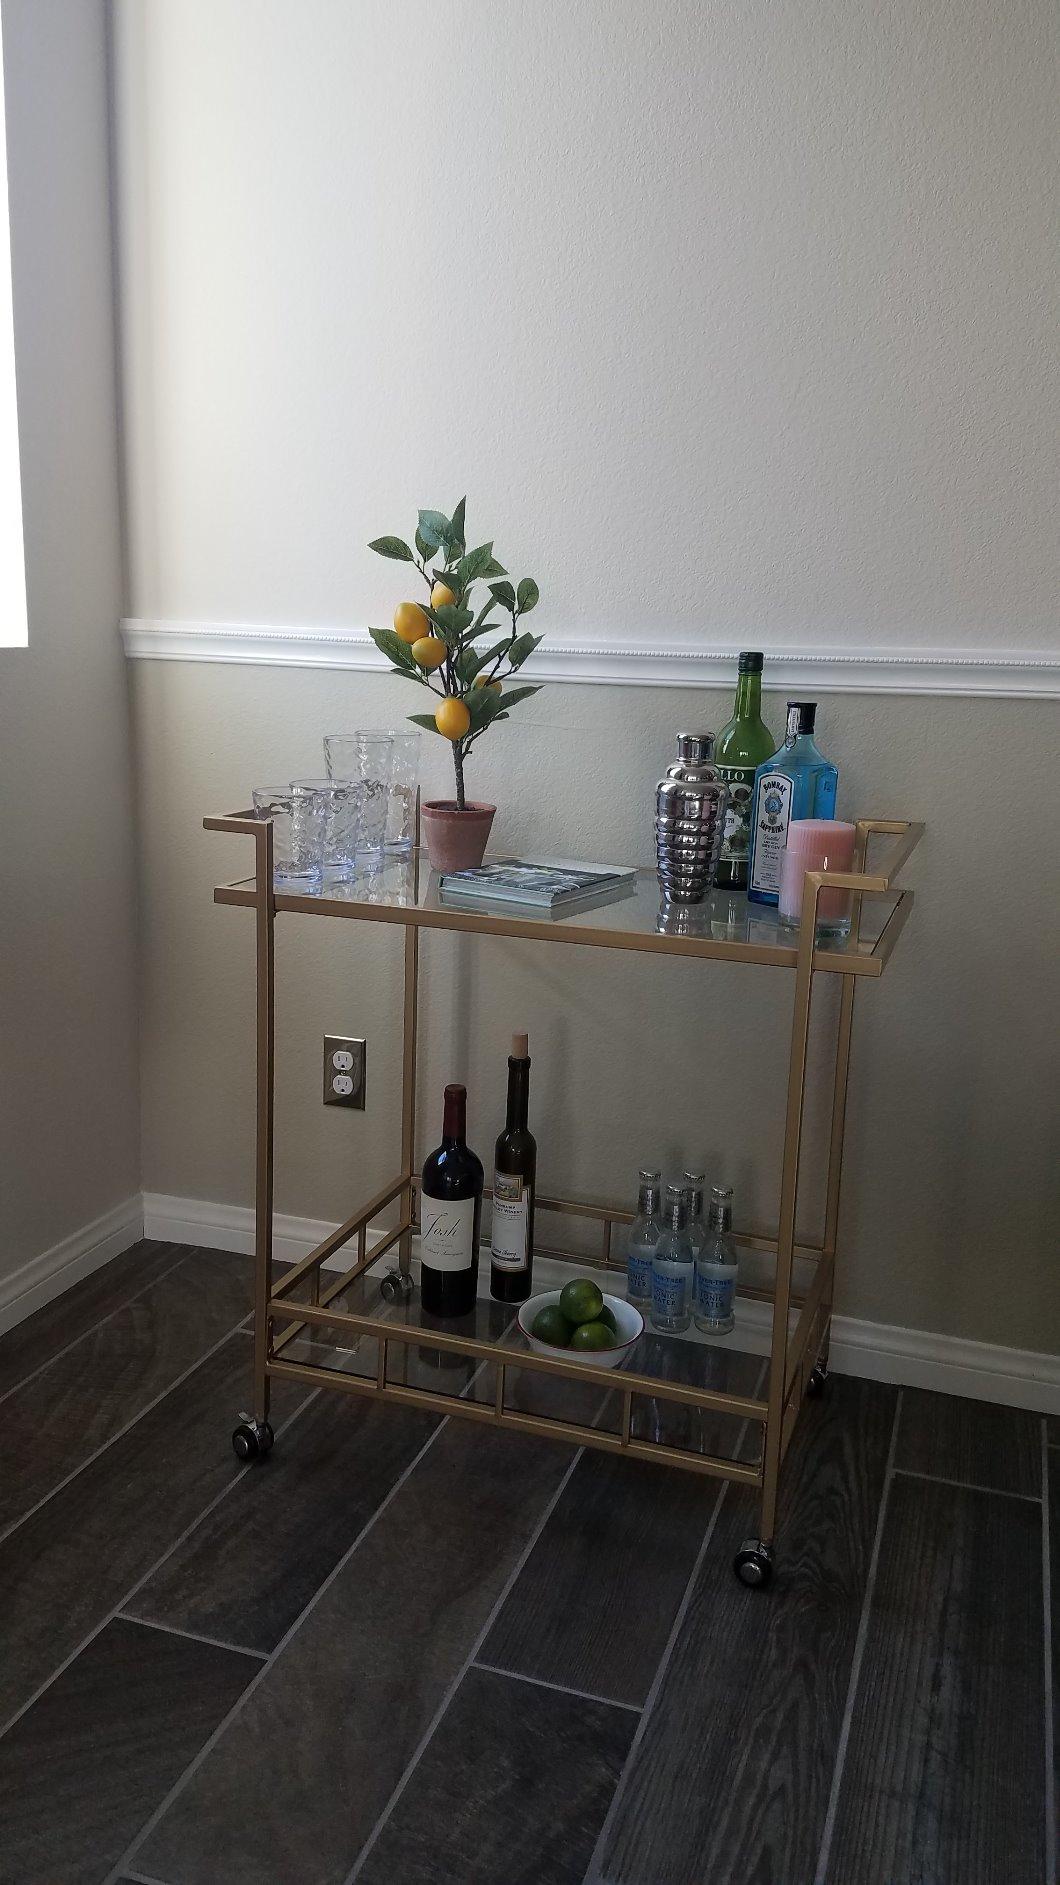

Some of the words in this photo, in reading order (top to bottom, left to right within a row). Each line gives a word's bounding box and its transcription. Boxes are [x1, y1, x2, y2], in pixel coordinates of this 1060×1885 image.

[720, 769, 745, 782] LLO
[763, 780, 787, 796] BOMBAY
[758, 819, 785, 834] SAPPHIRE
[423, 1212, 461, 1240] Josh
